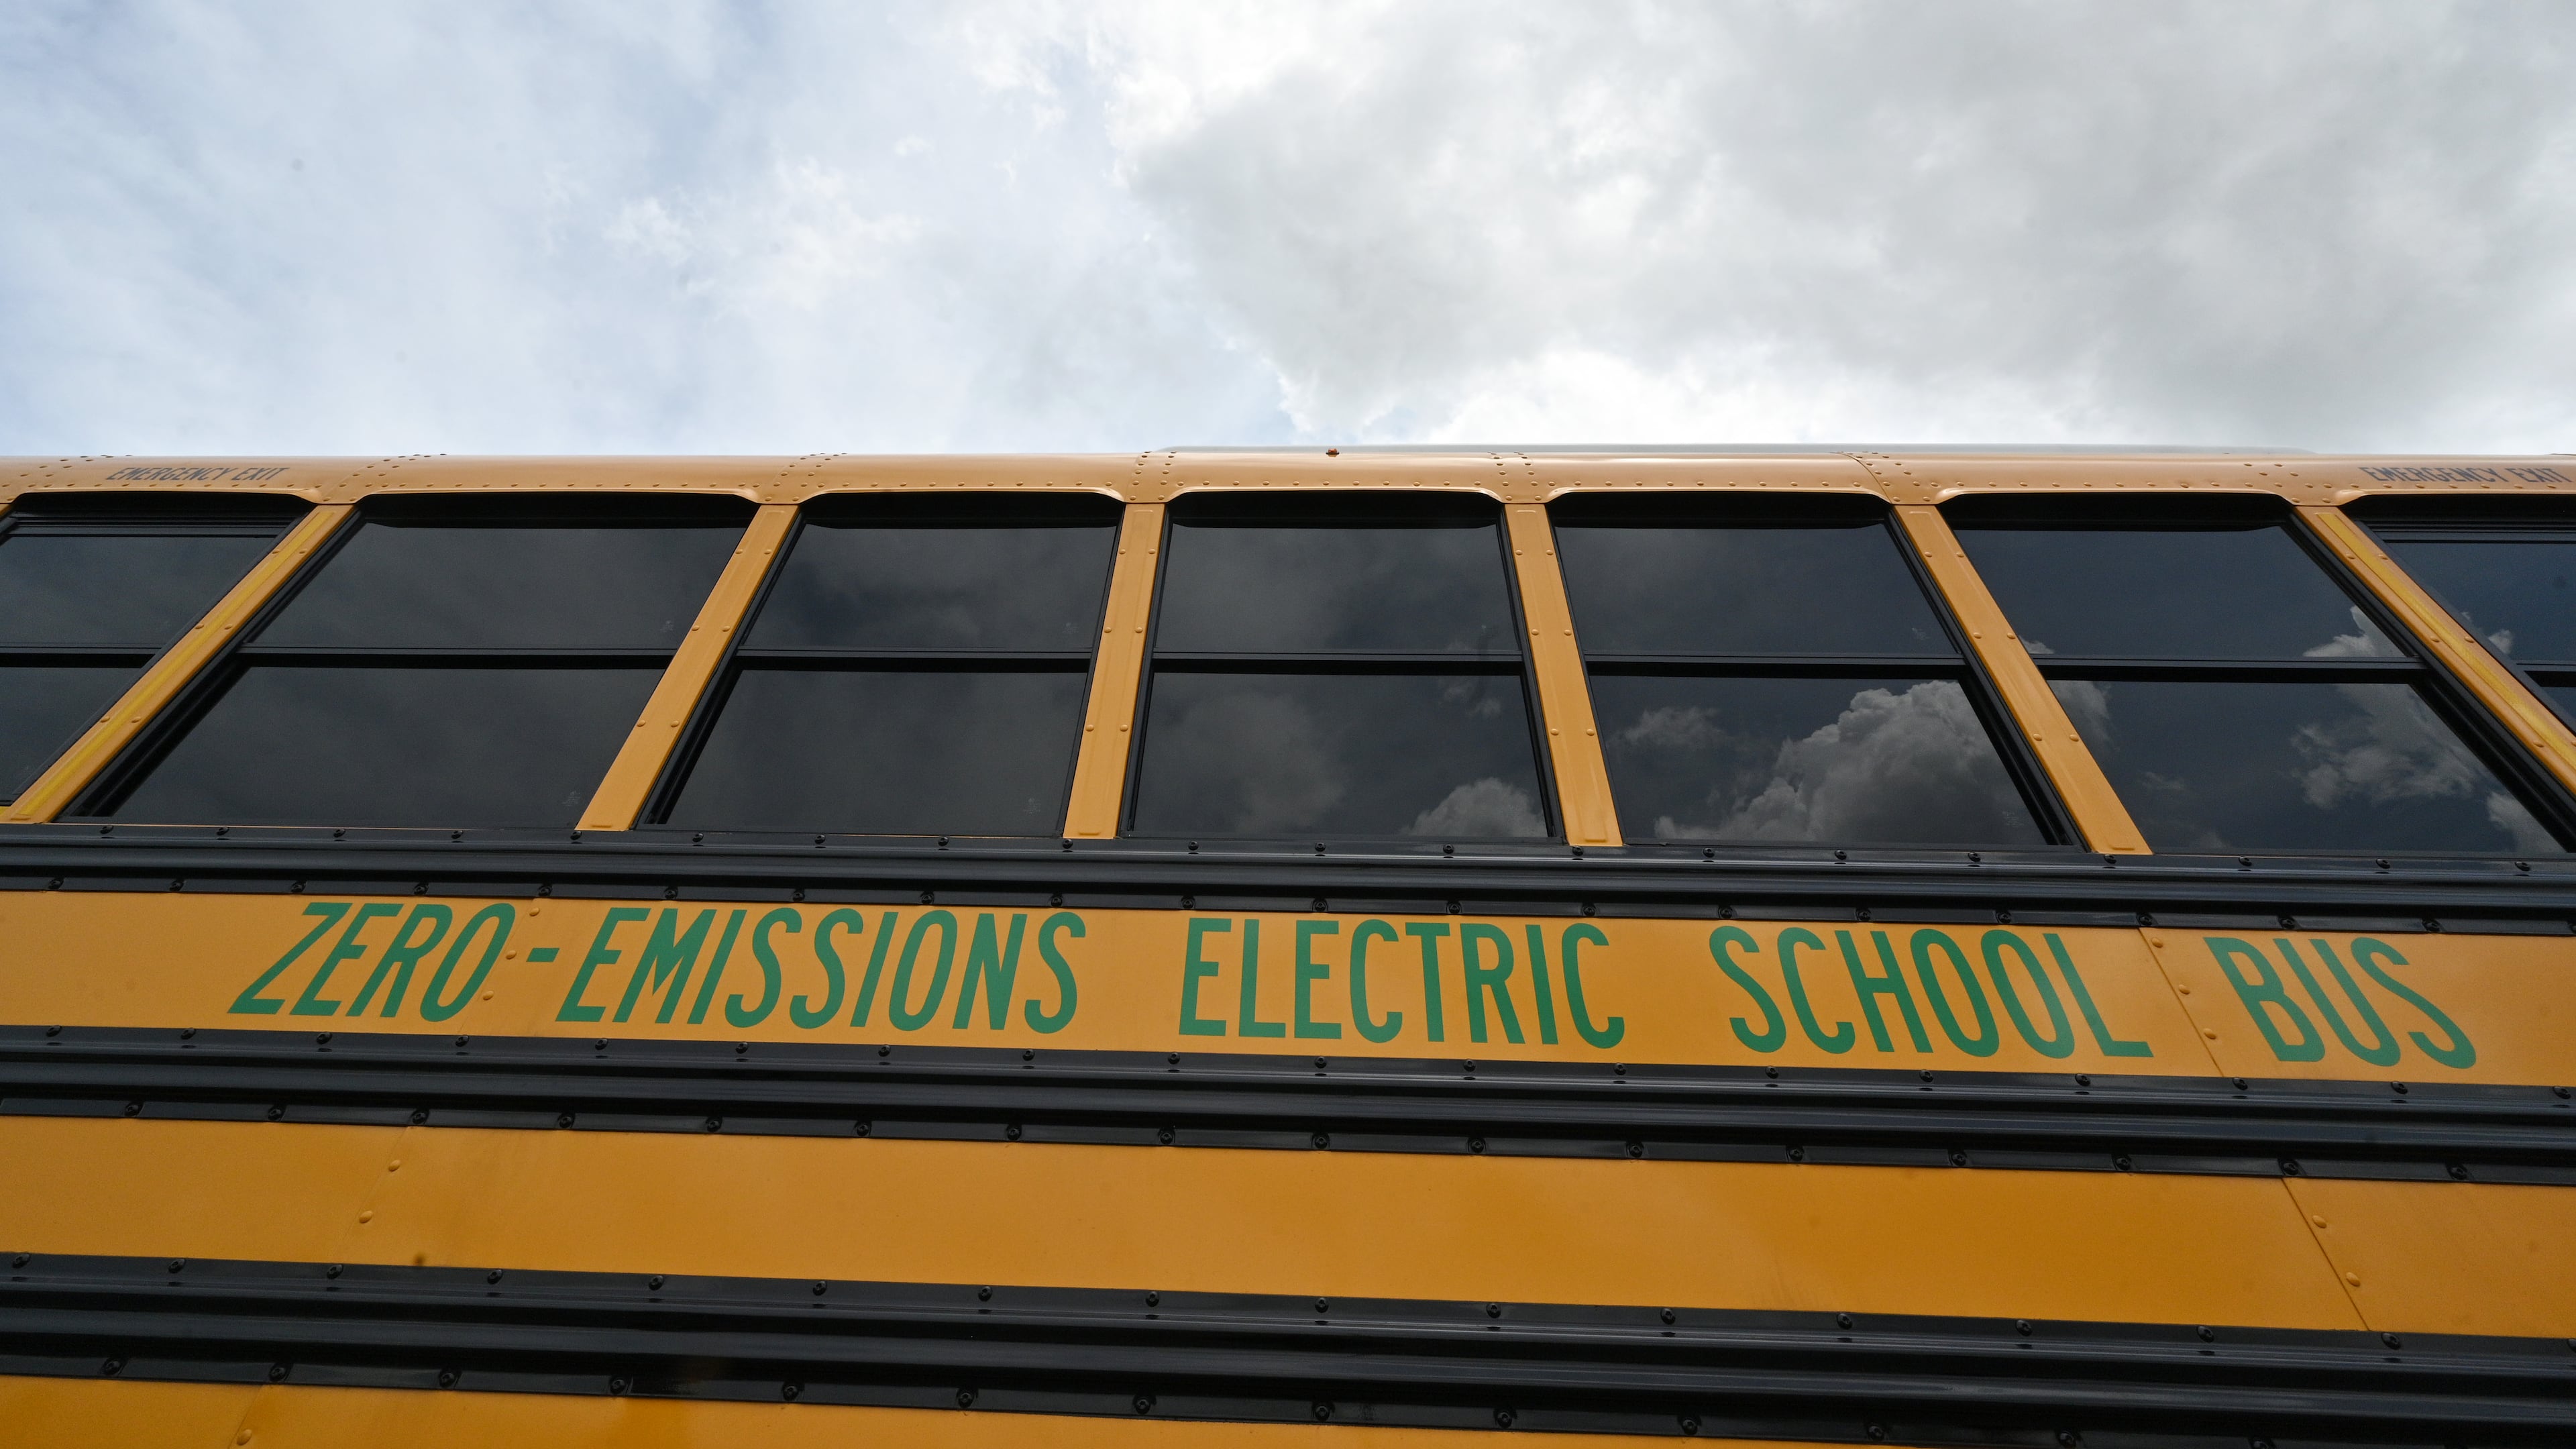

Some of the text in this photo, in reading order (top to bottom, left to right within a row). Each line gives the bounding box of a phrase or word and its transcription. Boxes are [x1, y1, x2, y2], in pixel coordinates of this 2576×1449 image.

[106, 468, 289, 480] EMERGENCY EXIT
[2359, 467, 2573, 482] EMERGENCY EXIT
[1179, 918, 1625, 1049] ELECTRIC
[1710, 926, 2153, 1058] SCHOOL
[2207, 938, 2476, 1069] BUS
